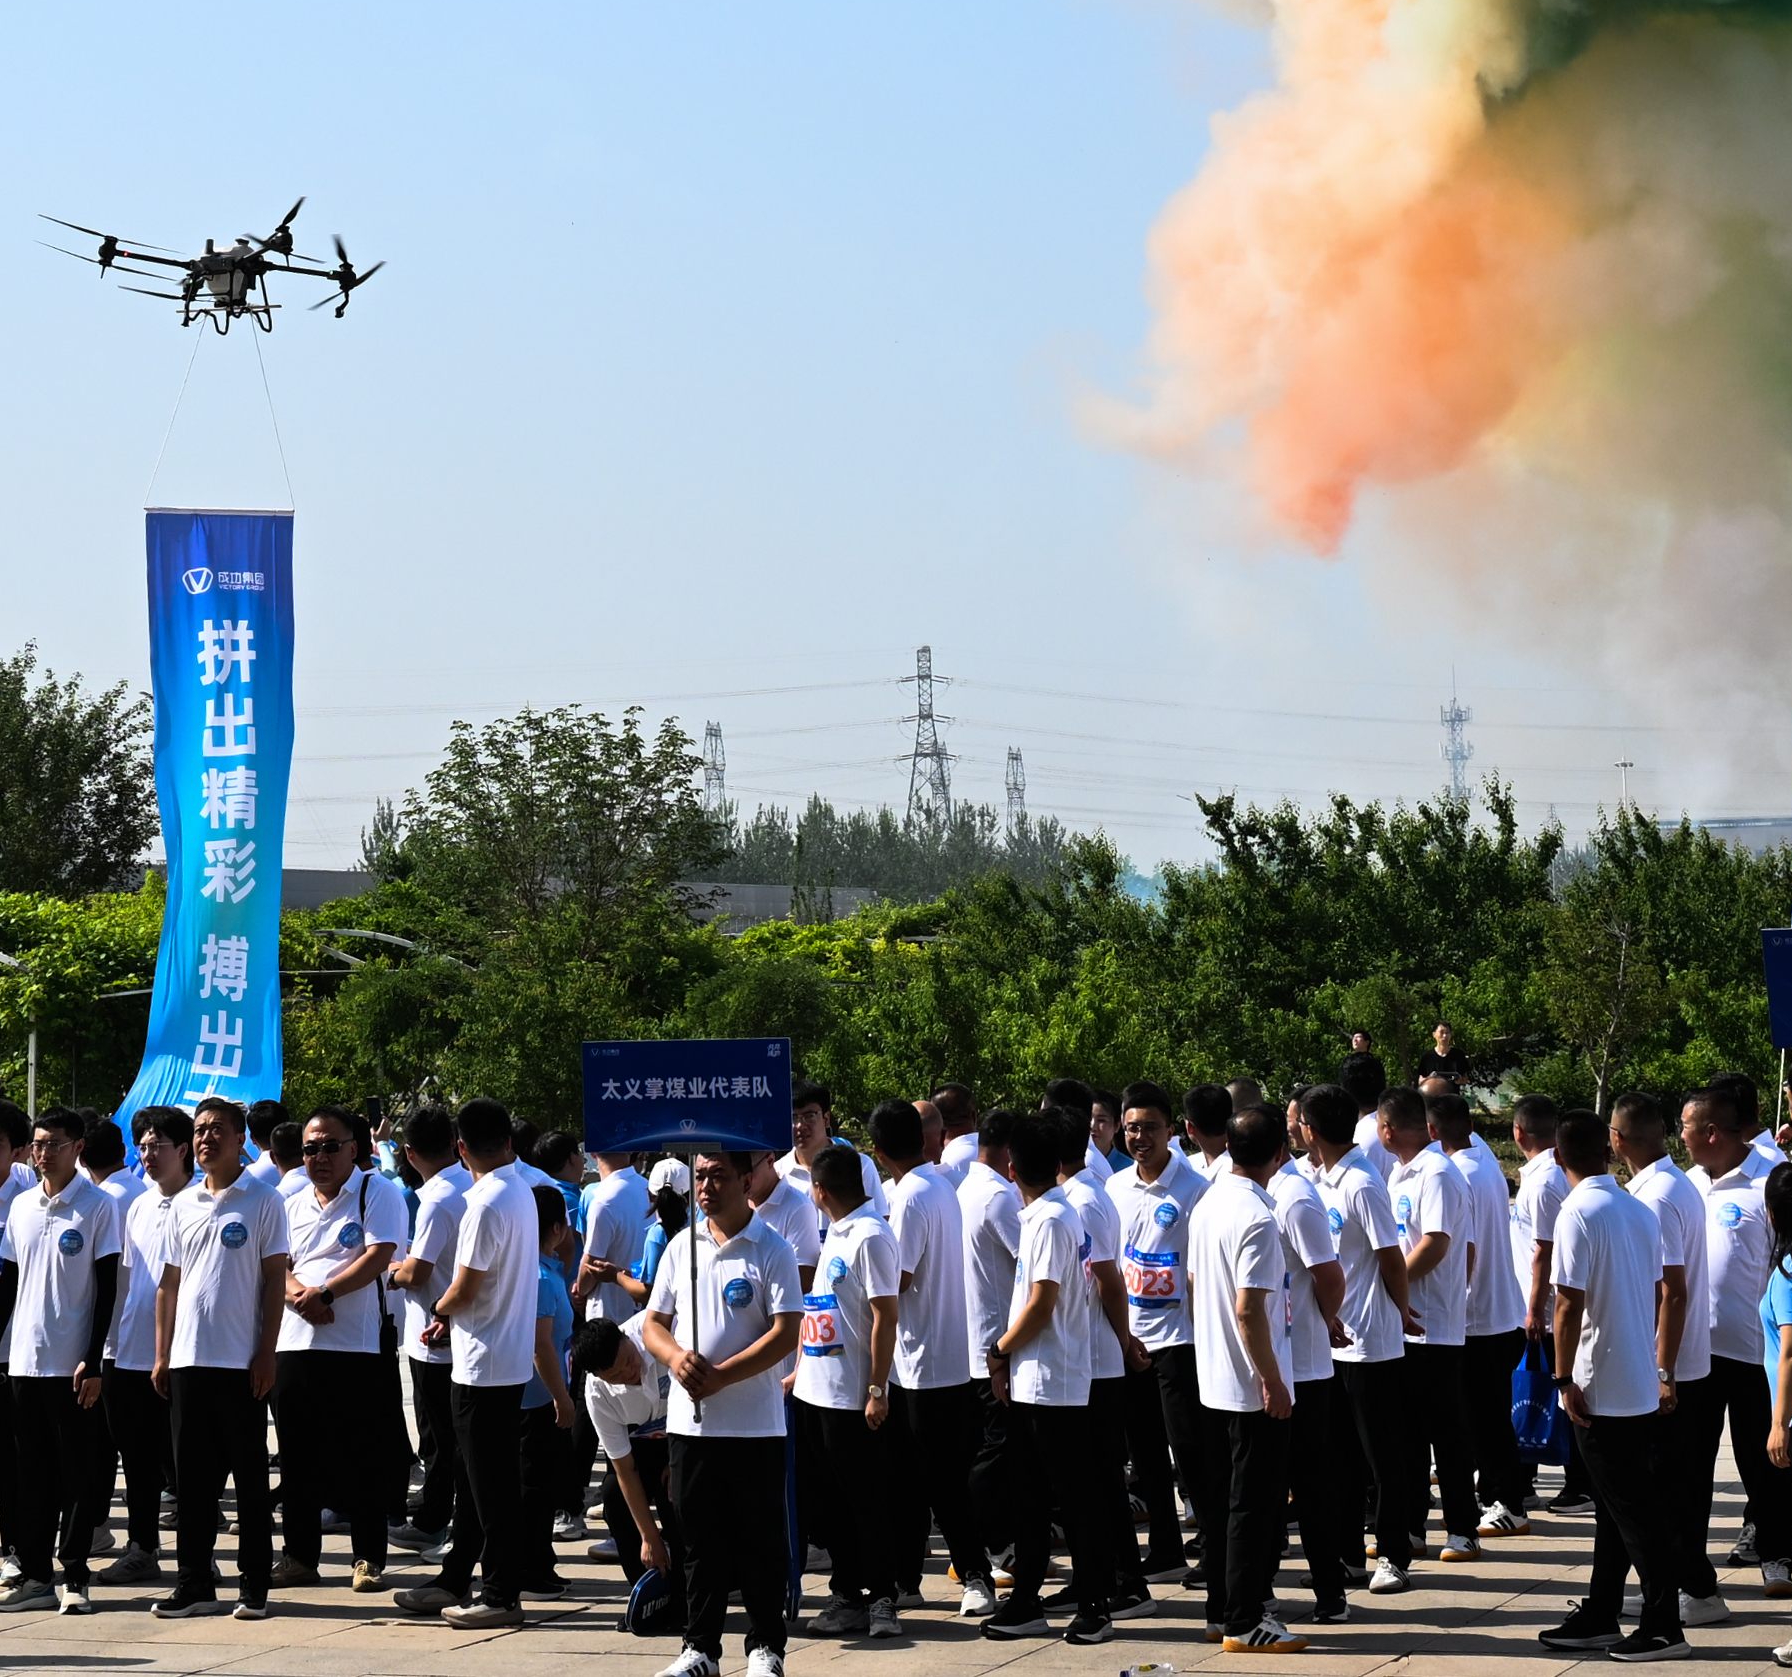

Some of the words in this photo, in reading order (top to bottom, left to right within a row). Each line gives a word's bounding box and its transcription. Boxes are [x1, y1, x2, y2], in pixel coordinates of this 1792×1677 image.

[197, 618, 259, 904] 拼出精彩
[601, 1076, 773, 1101] 太义掌煤业代表队
[1124, 1263, 1175, 1296] 6023
